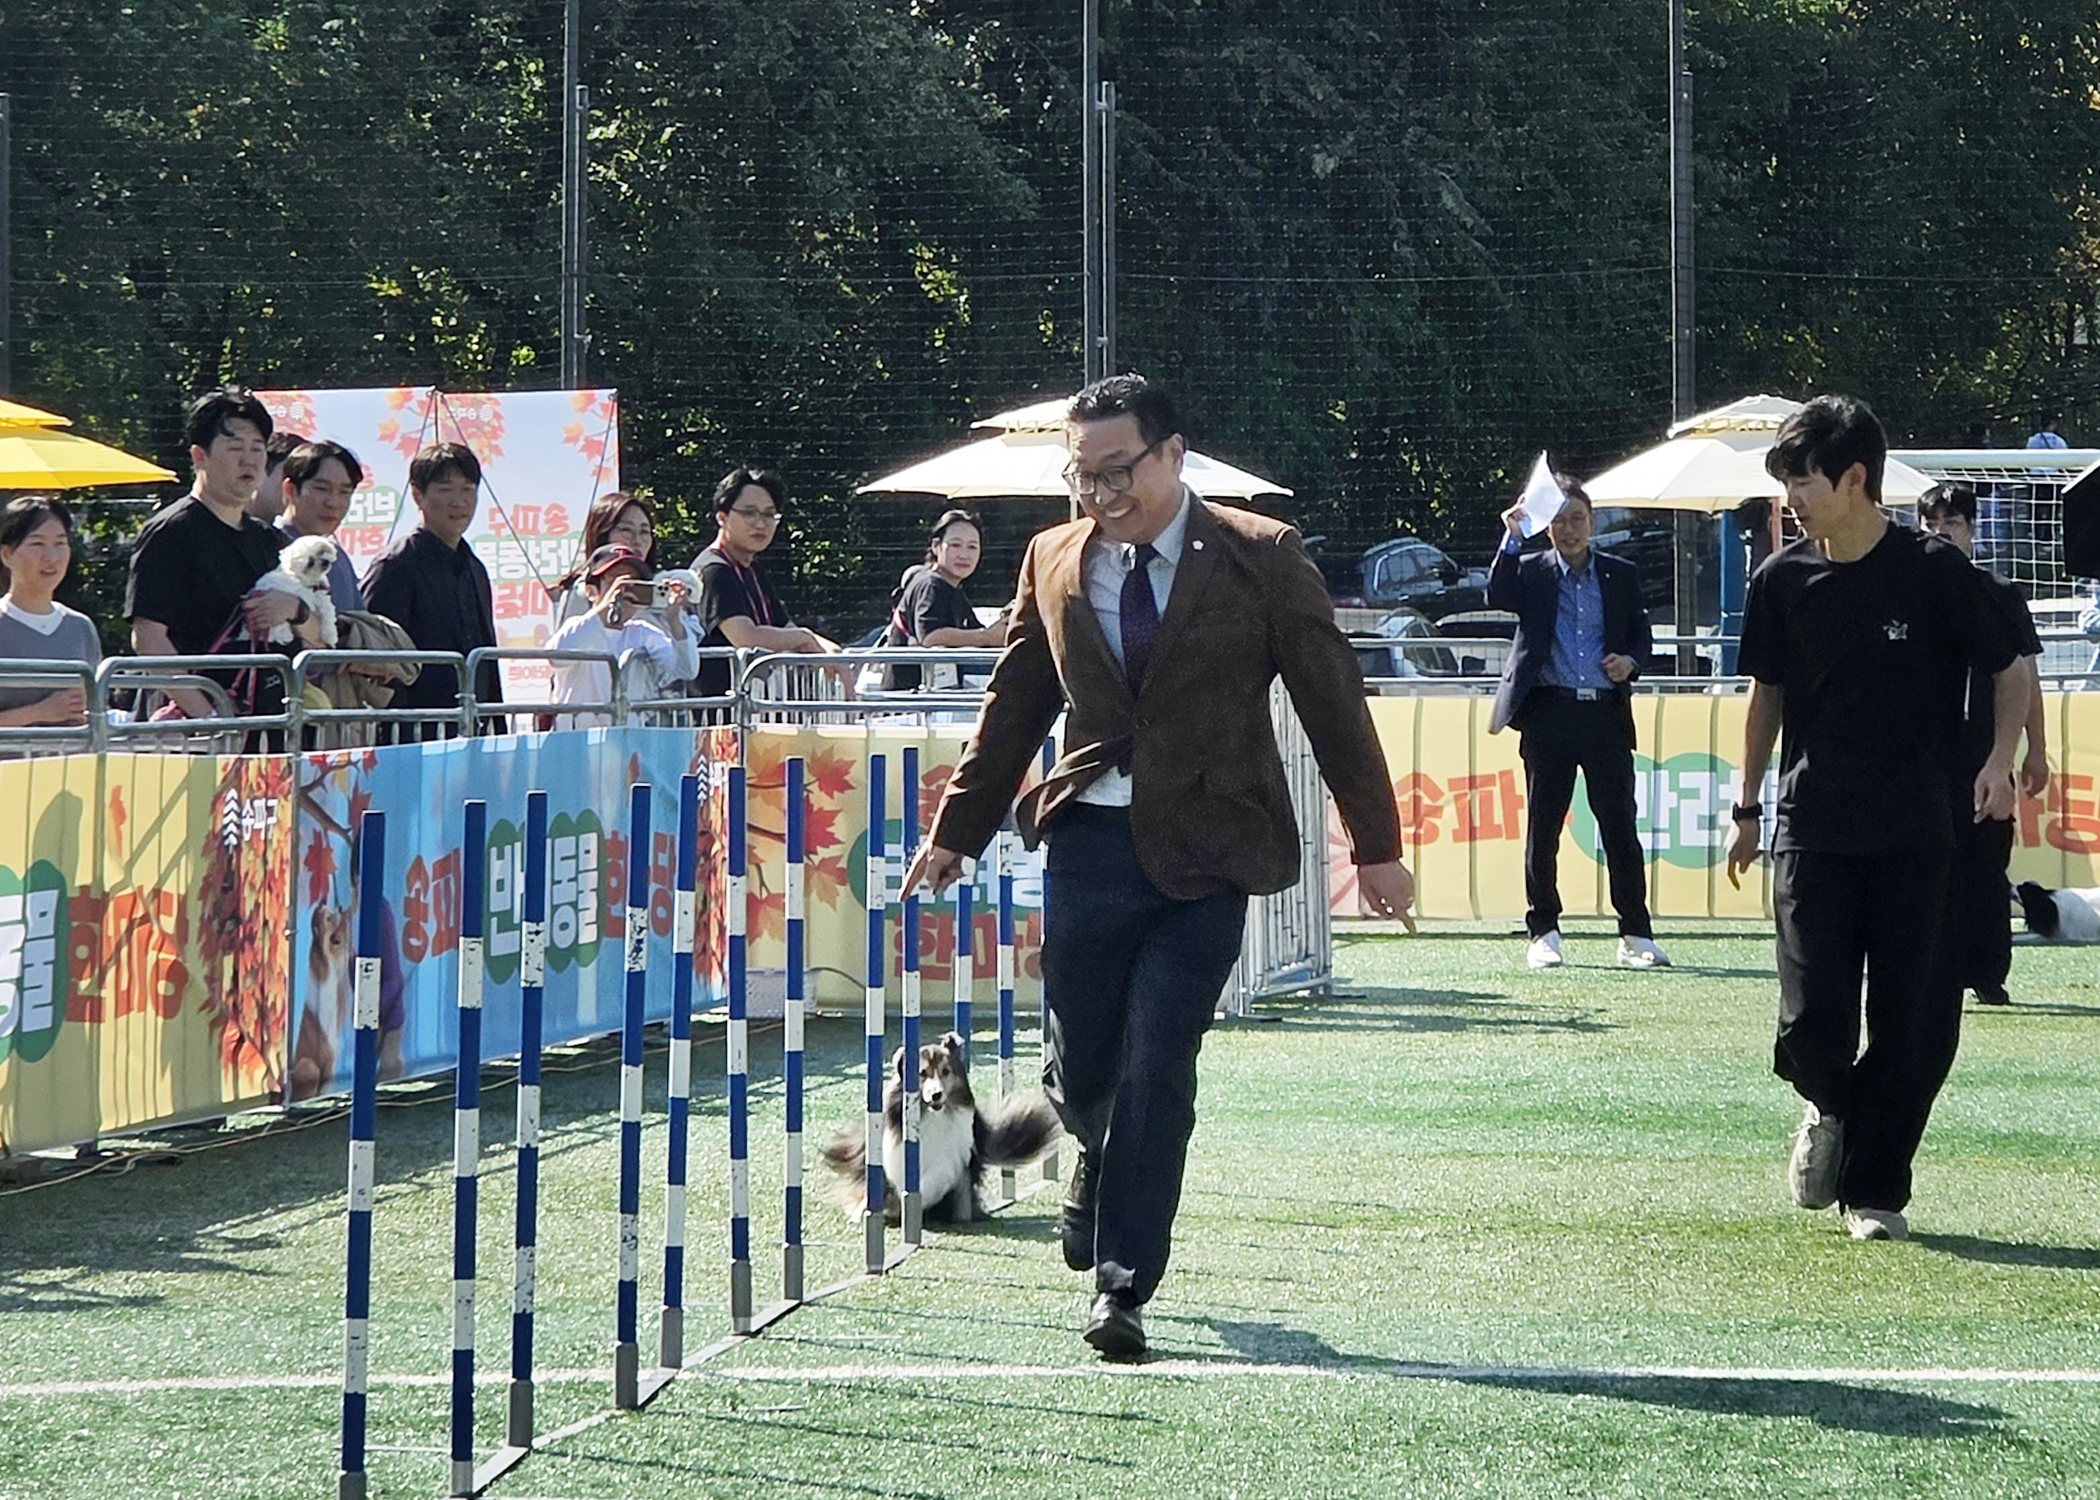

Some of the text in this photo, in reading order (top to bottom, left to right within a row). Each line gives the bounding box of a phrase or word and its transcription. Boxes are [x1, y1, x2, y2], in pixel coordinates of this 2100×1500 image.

[240, 797, 278, 841] 송파구
[1395, 769, 1524, 845] 송파
[402, 847, 461, 964] 송파
[604, 830, 677, 937] 한당
[66, 884, 189, 1023] 한마당
